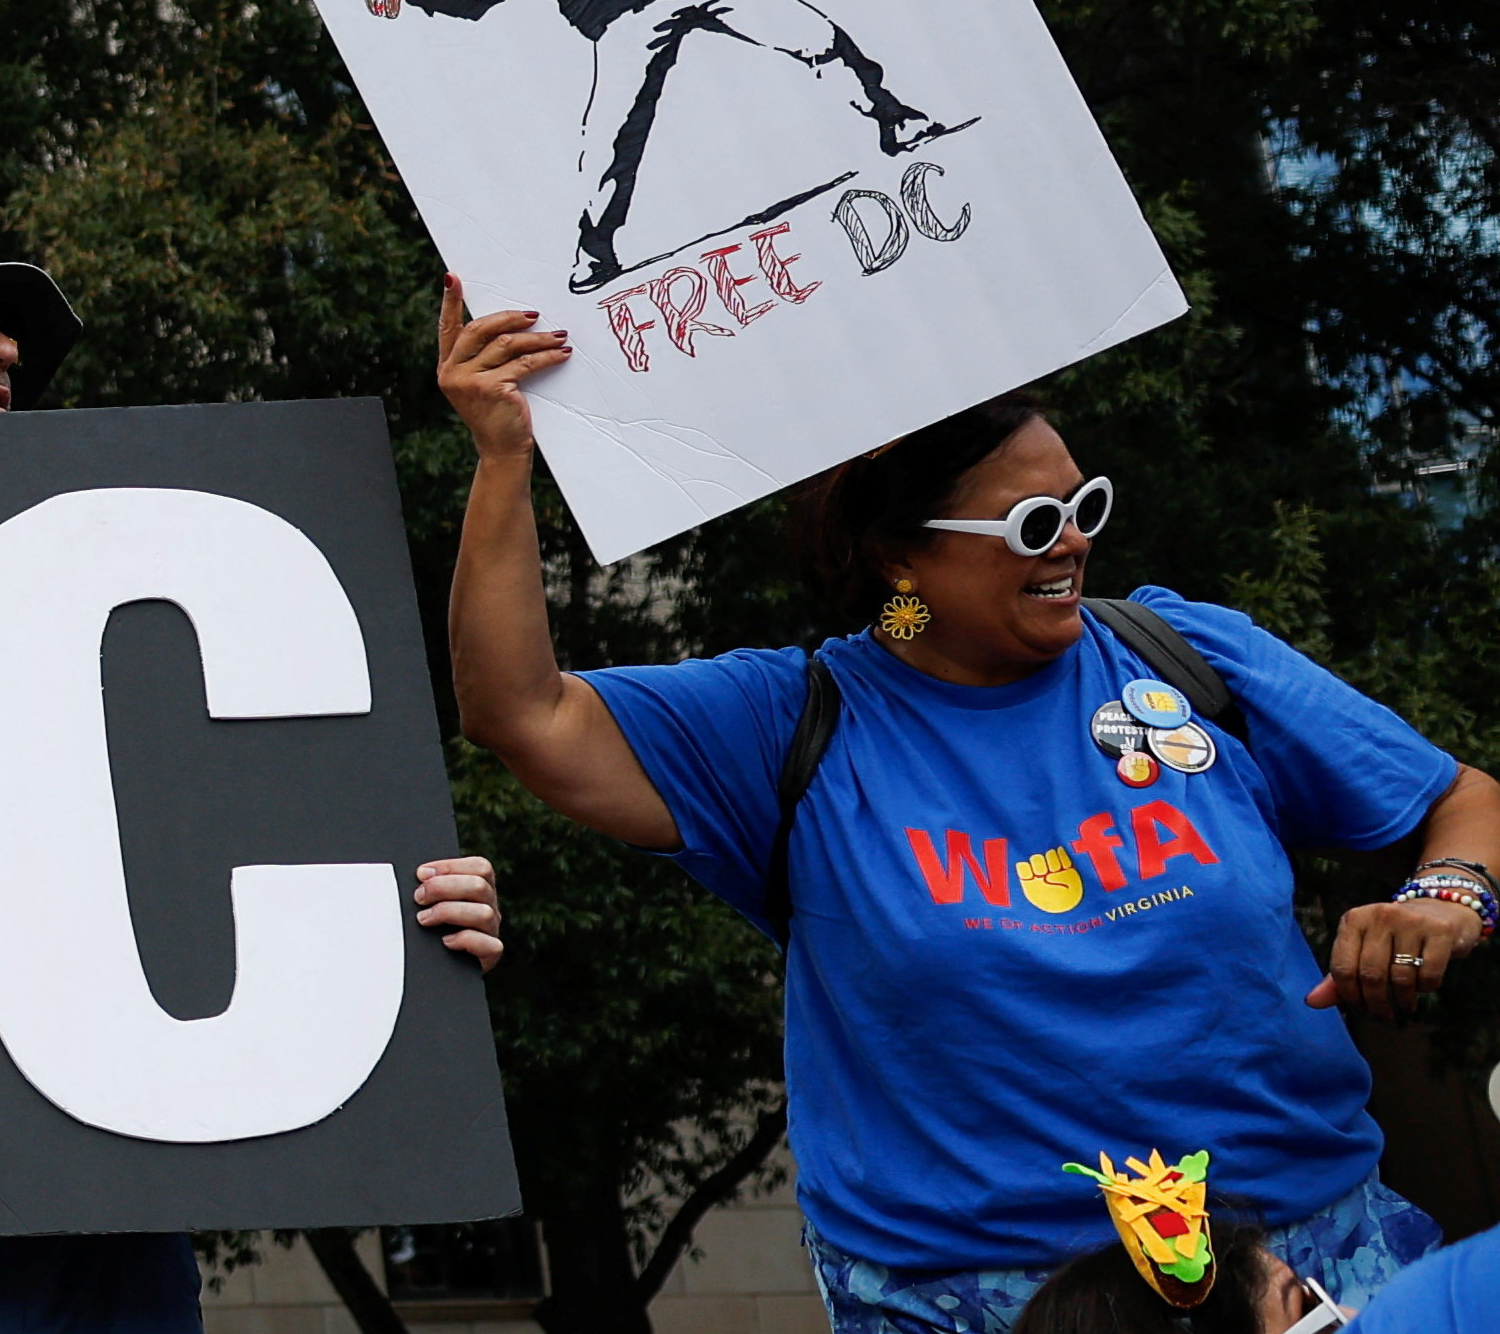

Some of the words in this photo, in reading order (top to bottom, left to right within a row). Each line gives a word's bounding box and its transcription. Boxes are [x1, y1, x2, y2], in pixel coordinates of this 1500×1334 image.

[597, 221, 823, 372] FREE
[831, 162, 972, 277] DC
[1029, 915, 1104, 936] ACTION
[1104, 884, 1196, 922] VIRGINIA
